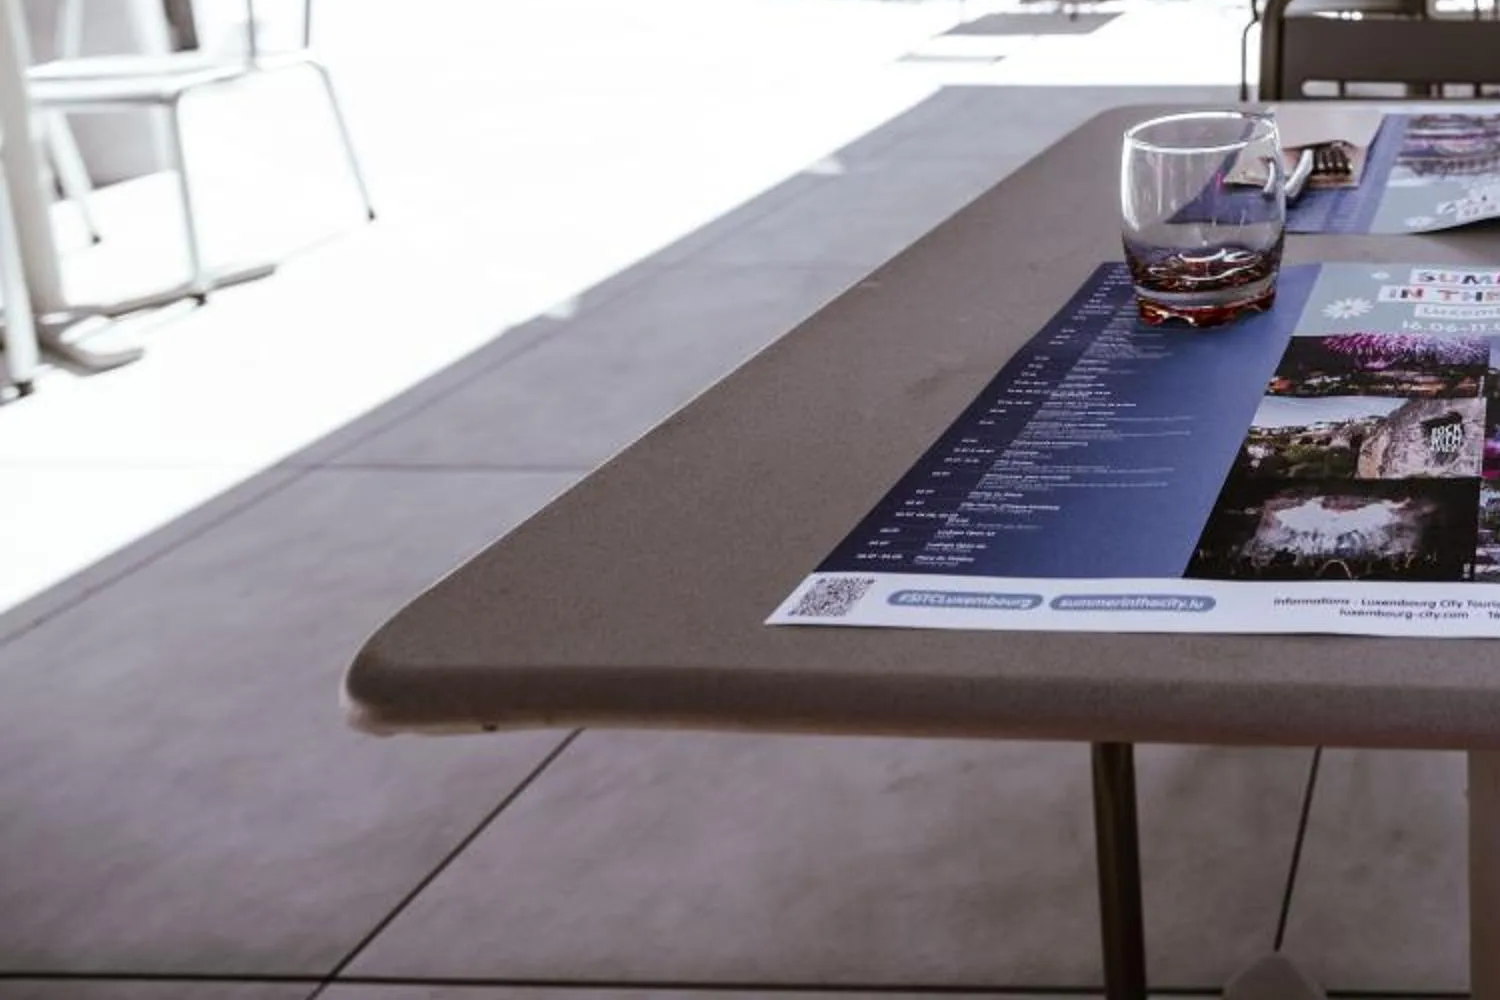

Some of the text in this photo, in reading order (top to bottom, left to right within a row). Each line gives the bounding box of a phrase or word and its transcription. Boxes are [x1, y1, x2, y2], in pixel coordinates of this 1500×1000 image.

[1388, 287, 1424, 299] IN
[1436, 288, 1500, 302] THE
[1361, 599, 1437, 610] Luxembourg
[1439, 599, 1464, 609] City
